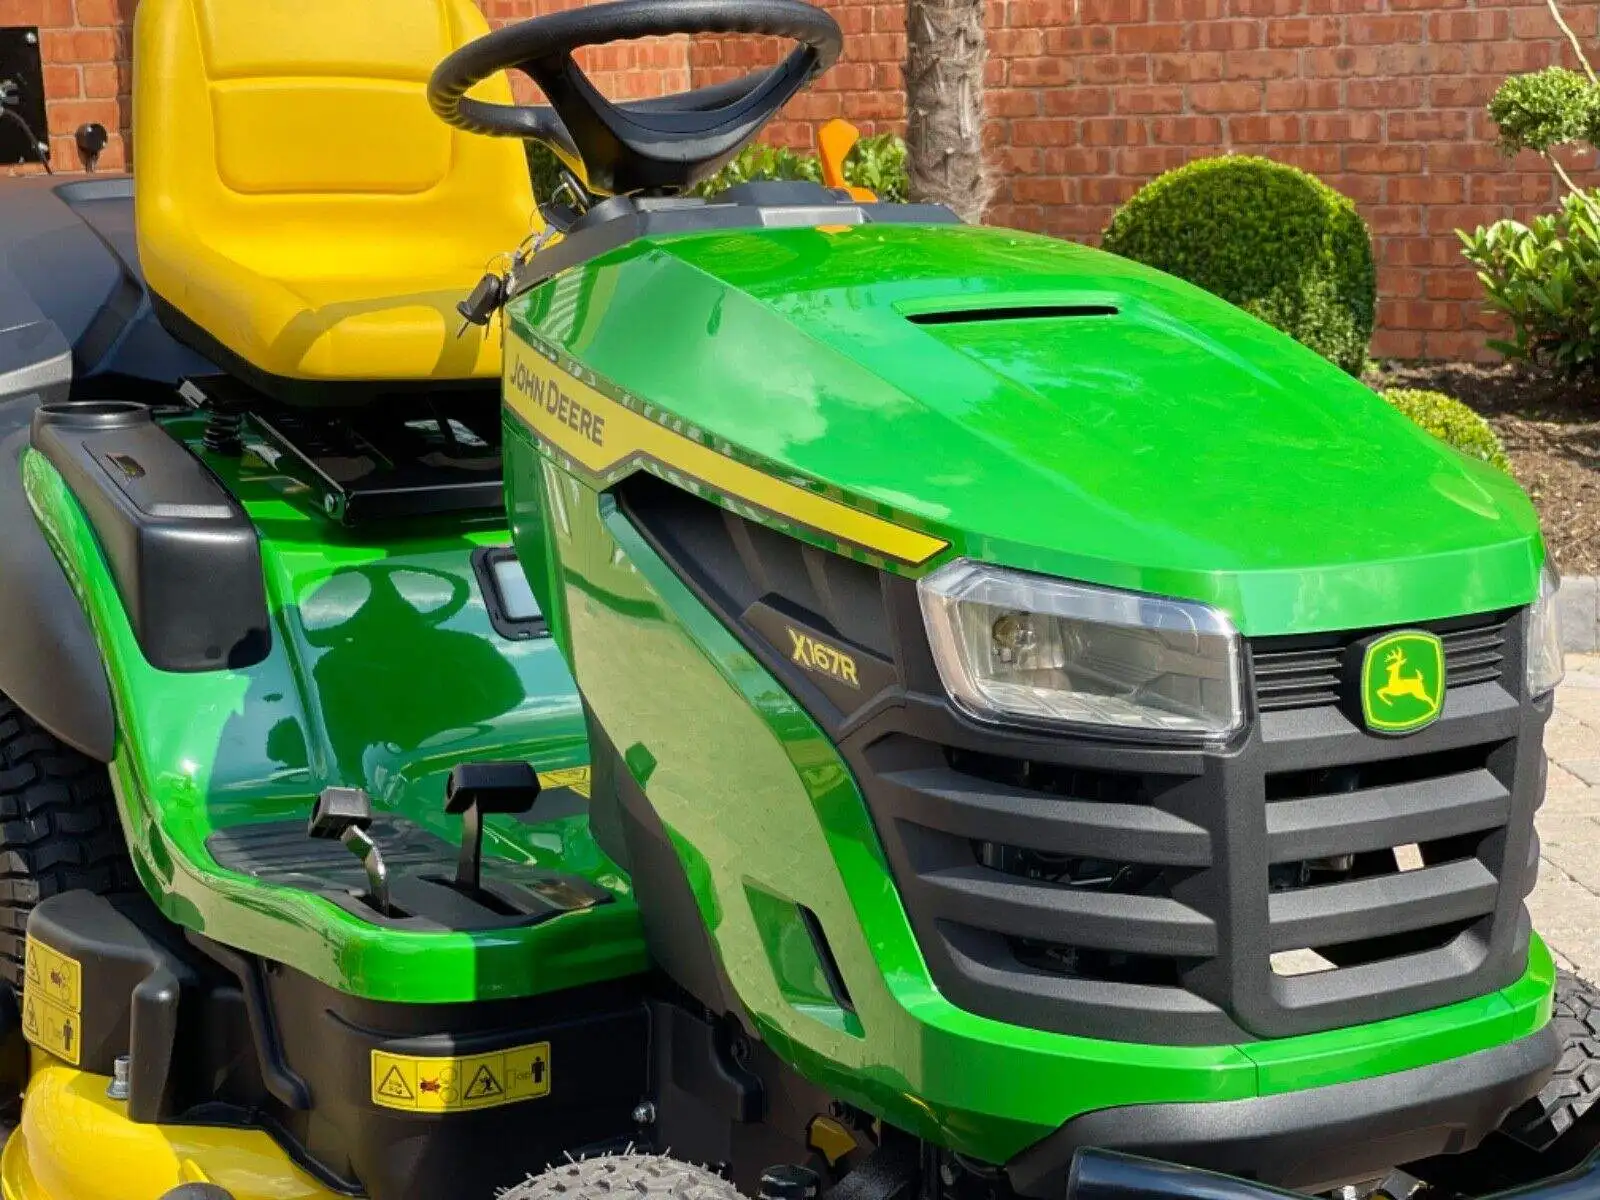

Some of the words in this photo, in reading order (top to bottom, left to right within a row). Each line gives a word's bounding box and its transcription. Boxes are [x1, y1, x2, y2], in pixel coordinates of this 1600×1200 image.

[511, 354, 545, 406] JOHN
[546, 379, 606, 447] DEERE
[786, 626, 860, 687] X167R
